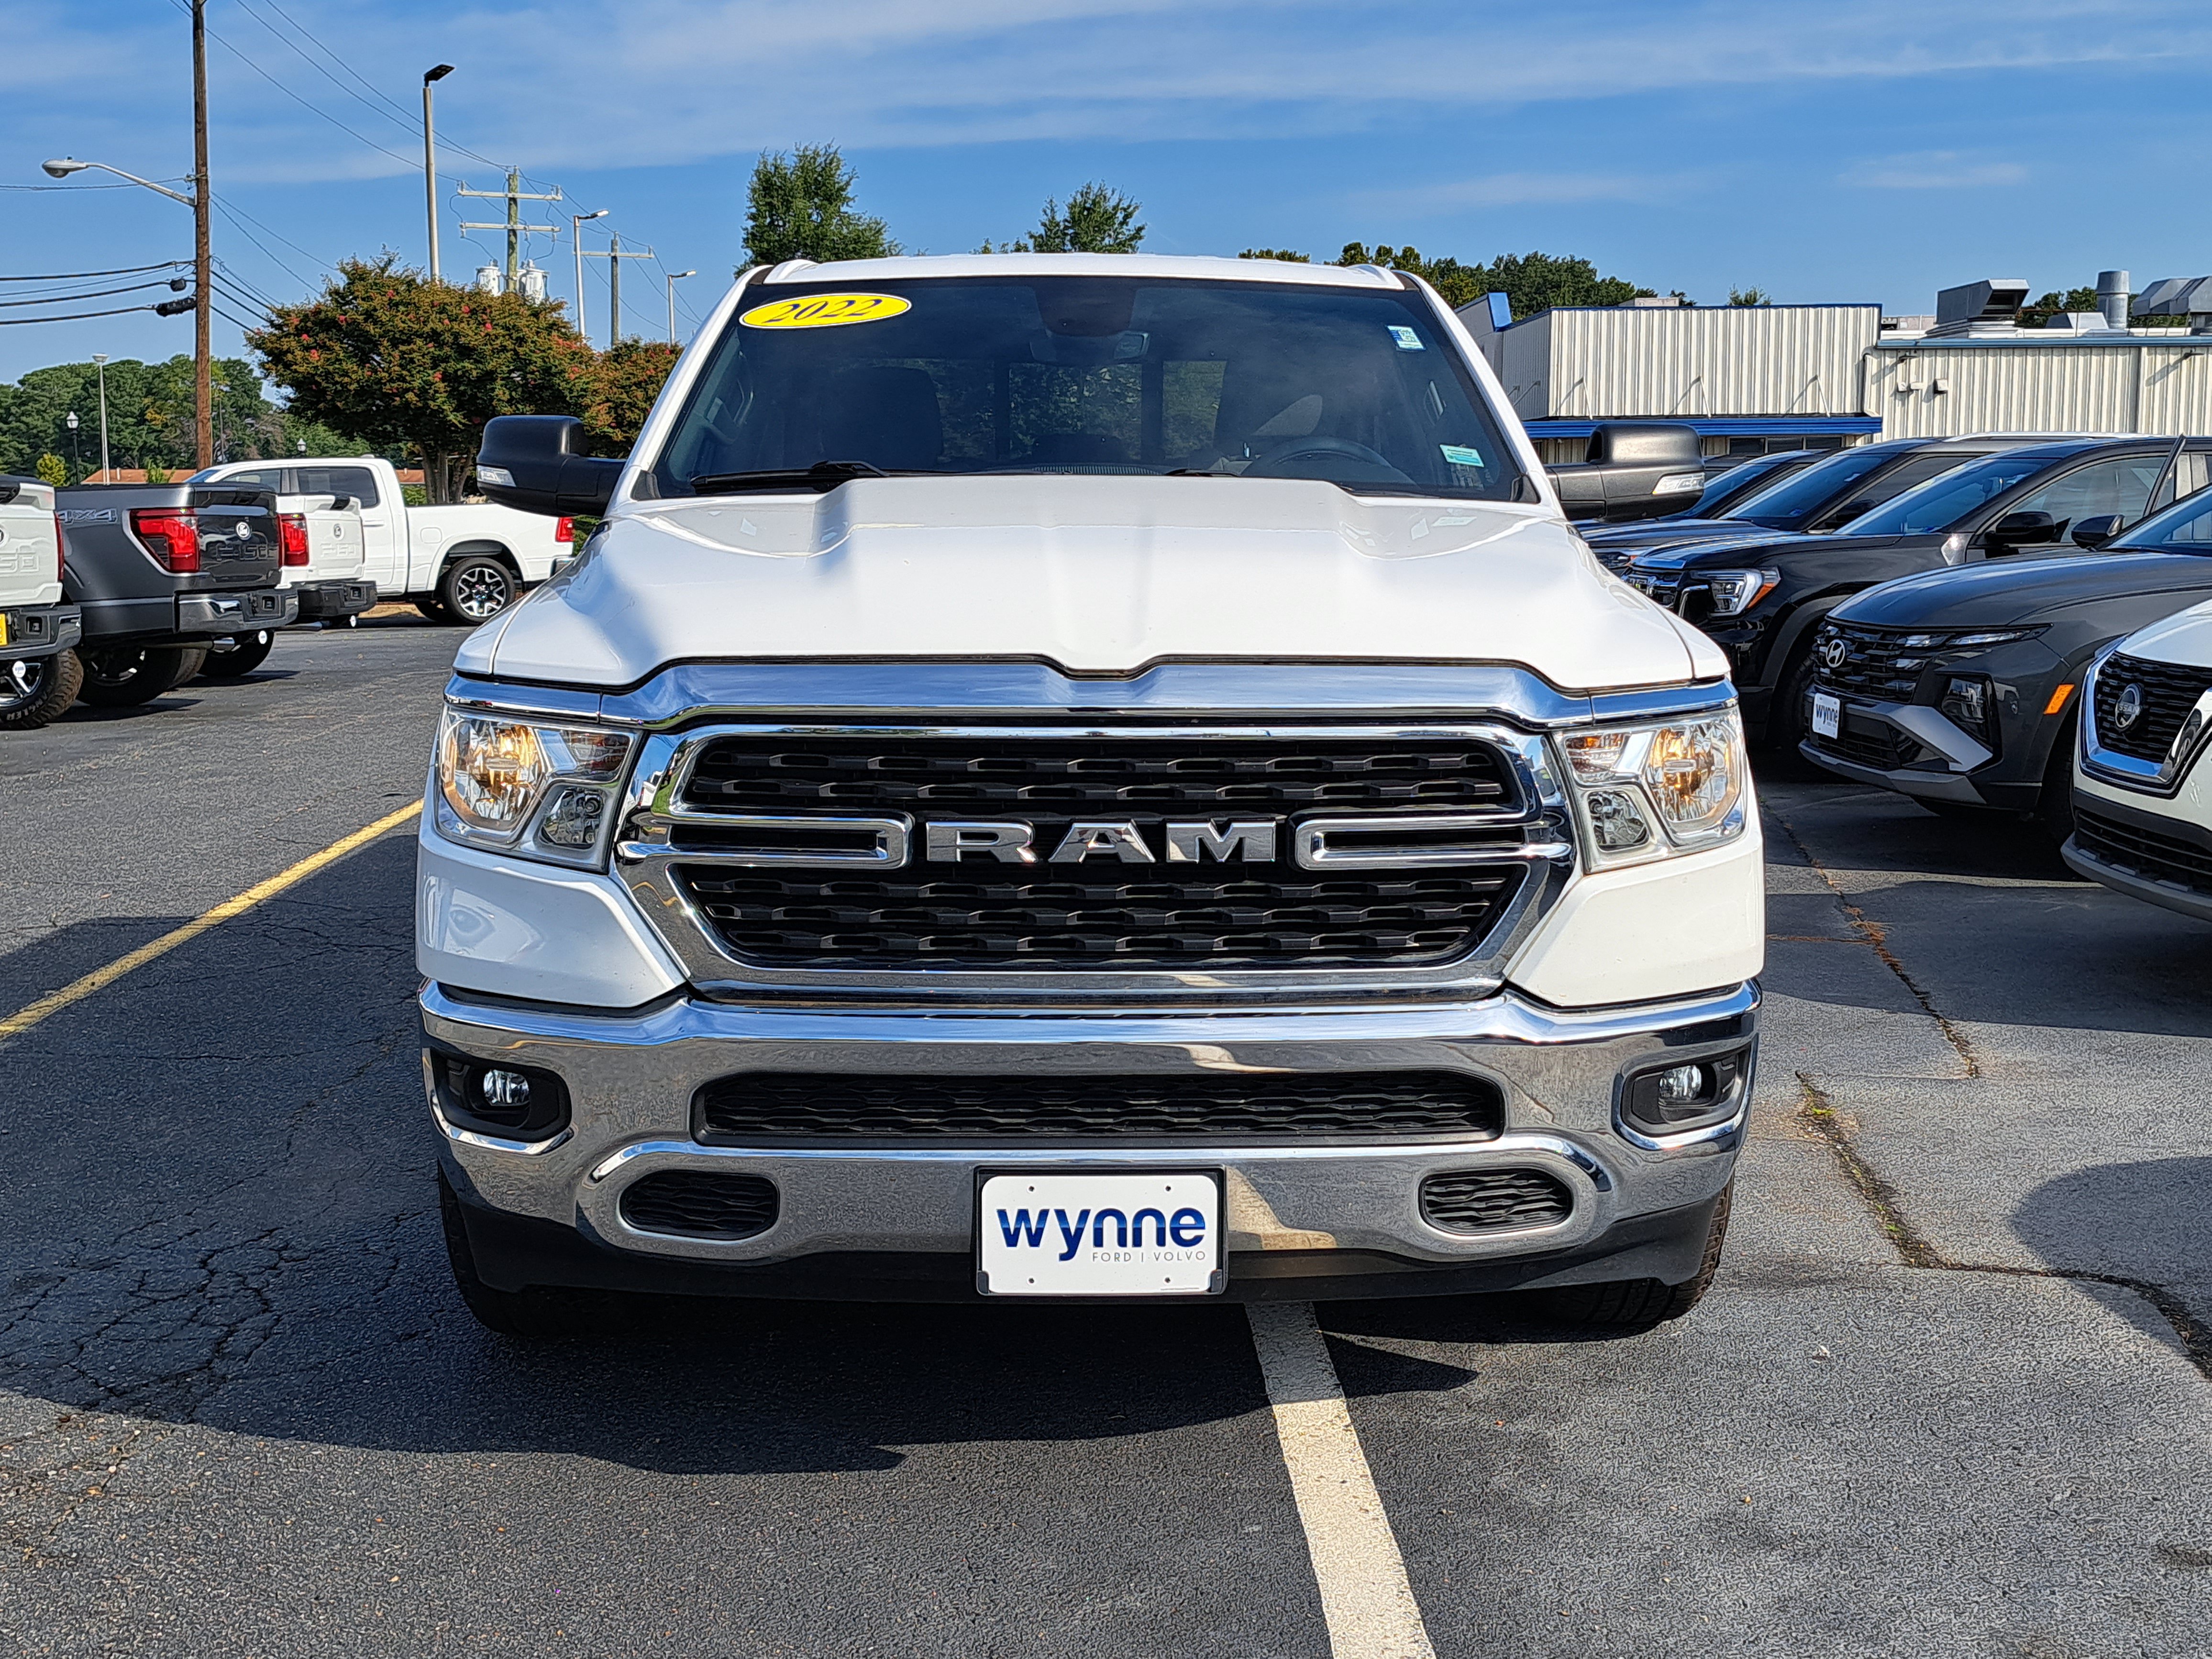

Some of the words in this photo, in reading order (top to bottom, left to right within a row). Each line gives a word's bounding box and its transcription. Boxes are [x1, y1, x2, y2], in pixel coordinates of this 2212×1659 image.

[761, 299, 883, 324] 2022
[1815, 703, 1838, 724] wynne
[926, 819, 1276, 863] RAM
[996, 1207, 1206, 1262] wynne
[1092, 1251, 1131, 1262] FORD
[1153, 1250, 1206, 1262] VOLVO
